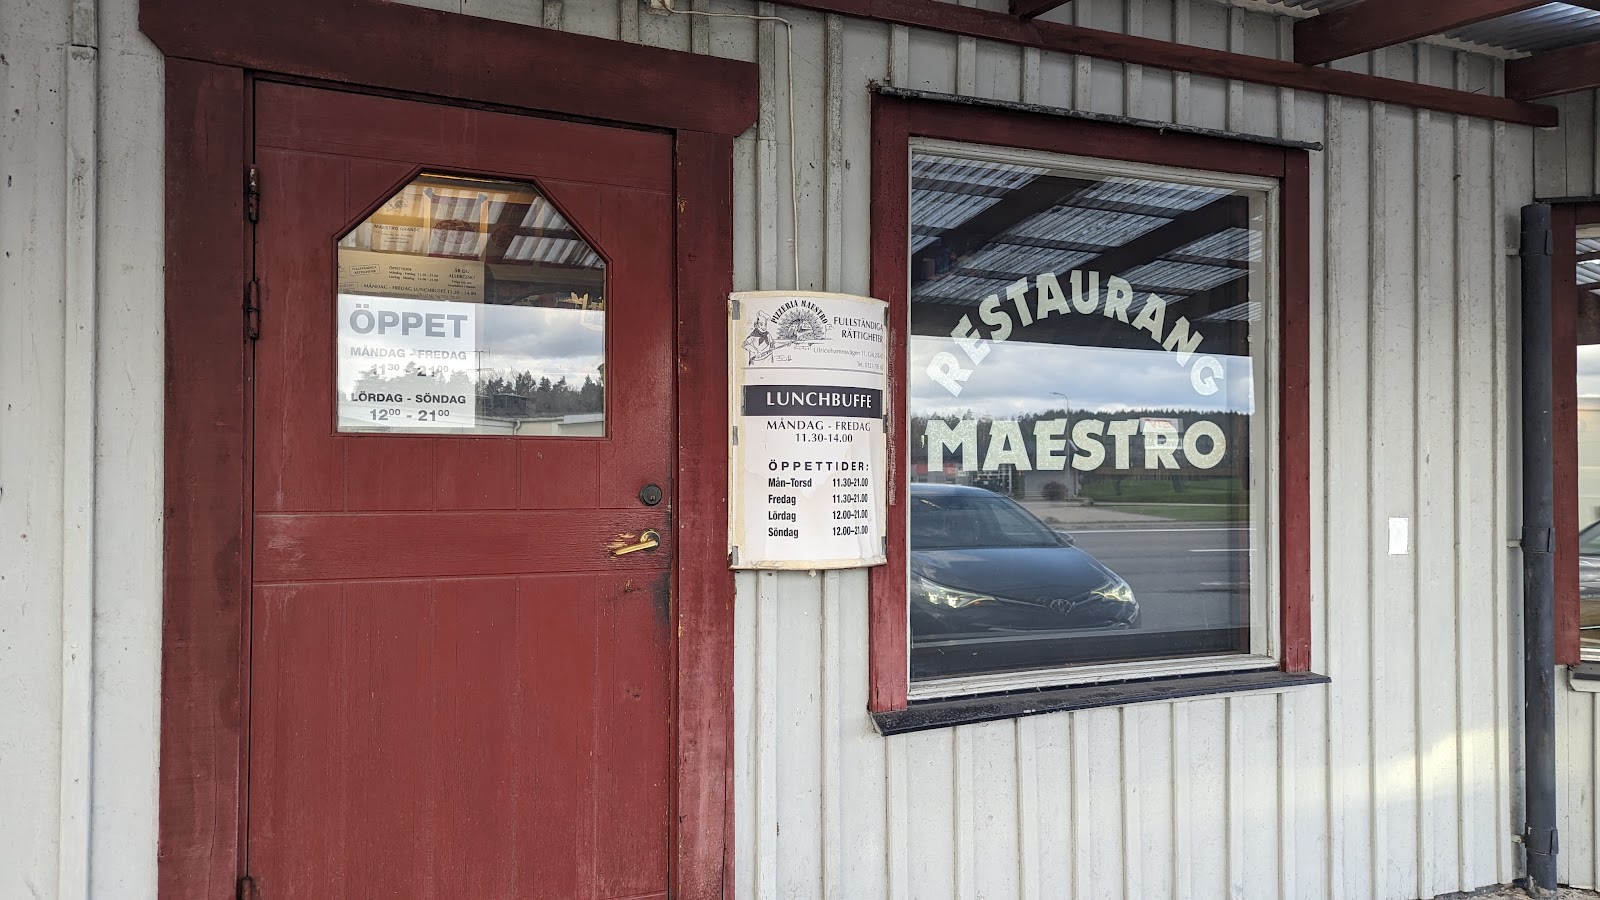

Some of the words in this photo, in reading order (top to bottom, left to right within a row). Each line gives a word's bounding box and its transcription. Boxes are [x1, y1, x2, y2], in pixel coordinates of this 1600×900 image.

[770, 299, 799, 325] PIZZERIA
[800, 299, 829, 325] MAESTRO
[349, 303, 468, 339] ÖPPET
[833, 315, 884, 332] FULLSTÄNDIGA
[841, 328, 884, 343] RÄTTIGHETER
[926, 269, 1225, 398] RESTAURANG
[350, 344, 406, 358] MÅNDAG
[417, 349, 467, 360] FREDAG
[351, 391, 403, 403] LÖRDAG
[415, 393, 466, 404] SÖNDAG
[766, 391, 872, 409] LUNCHBUFFE
[766, 417, 824, 430] MÅNDAG
[835, 421, 871, 432] FREDAG
[796, 433, 853, 443] 11.30-14.00
[925, 418, 1227, 472] MAESTRO
[768, 459, 869, 471] ÖPPETTIDER:
[768, 494, 797, 506] Fredag
[768, 511, 797, 522] Lördag
[768, 527, 799, 538] Söndag
